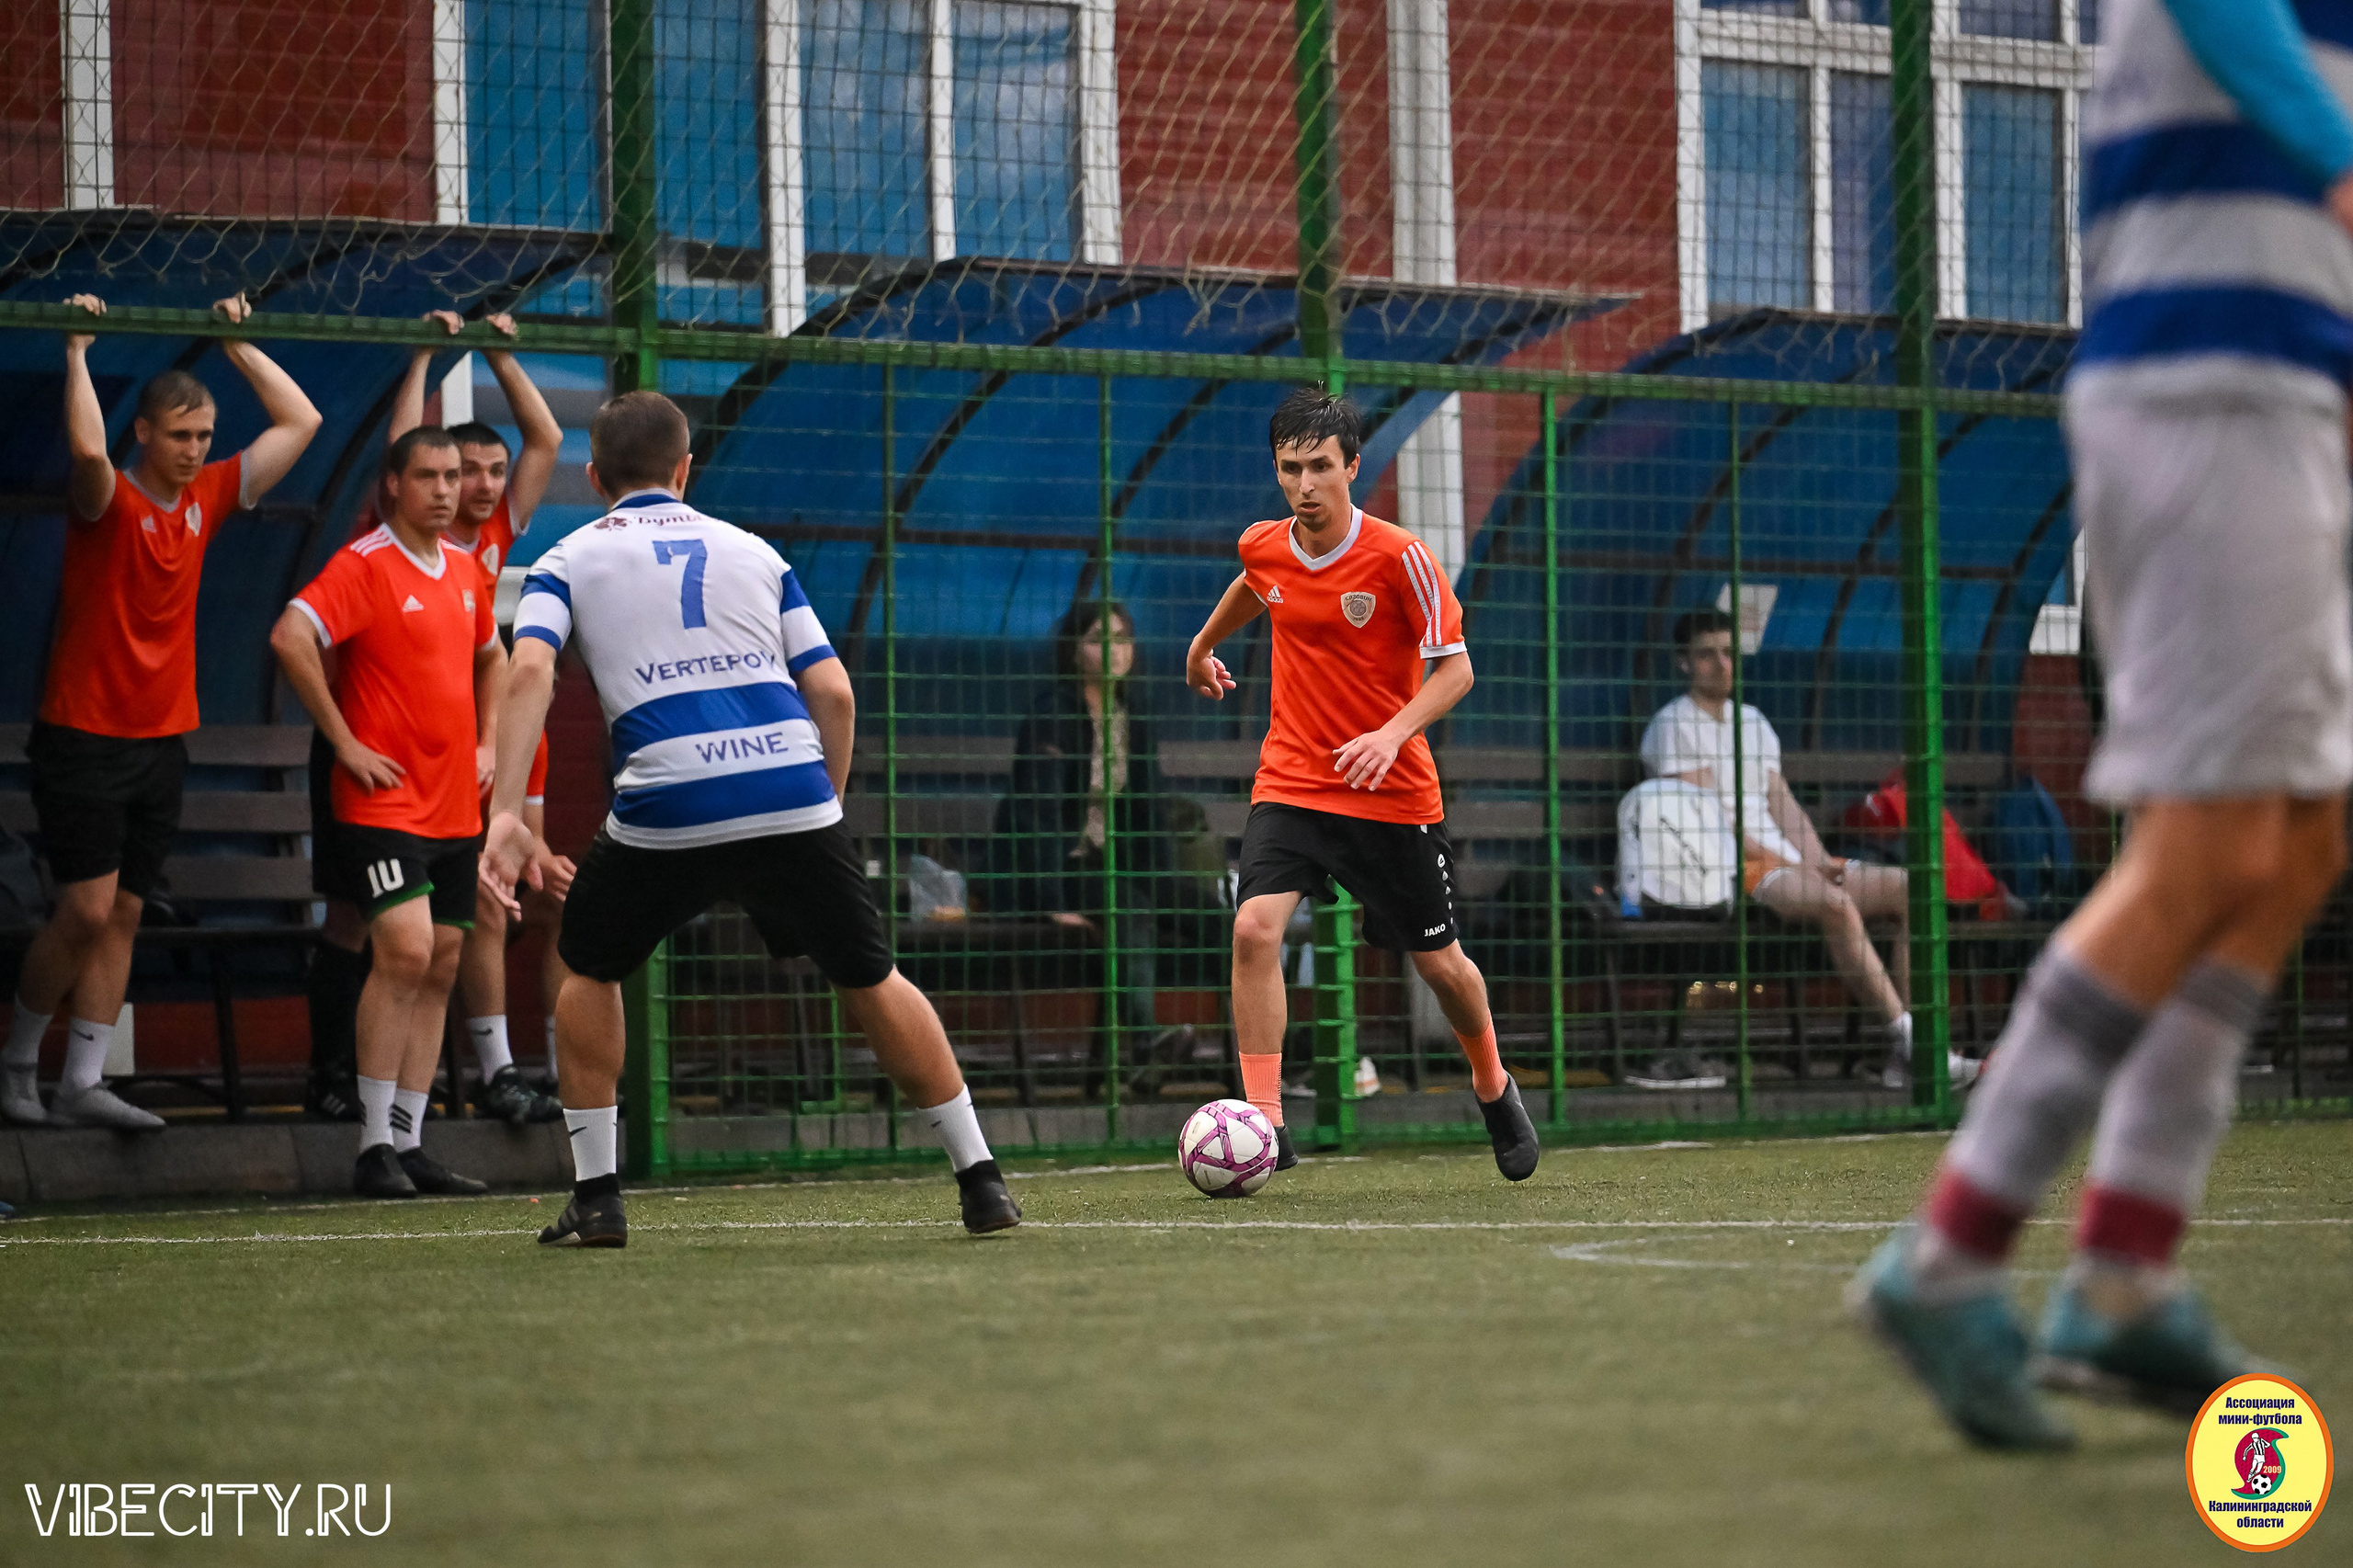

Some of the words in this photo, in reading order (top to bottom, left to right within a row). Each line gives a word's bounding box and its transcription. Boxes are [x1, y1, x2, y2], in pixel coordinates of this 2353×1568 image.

[651, 539, 708, 631] 7
[635, 650, 775, 685] VERTEPOV
[695, 732, 790, 764] WINE
[1424, 923, 1447, 937] JAKO
